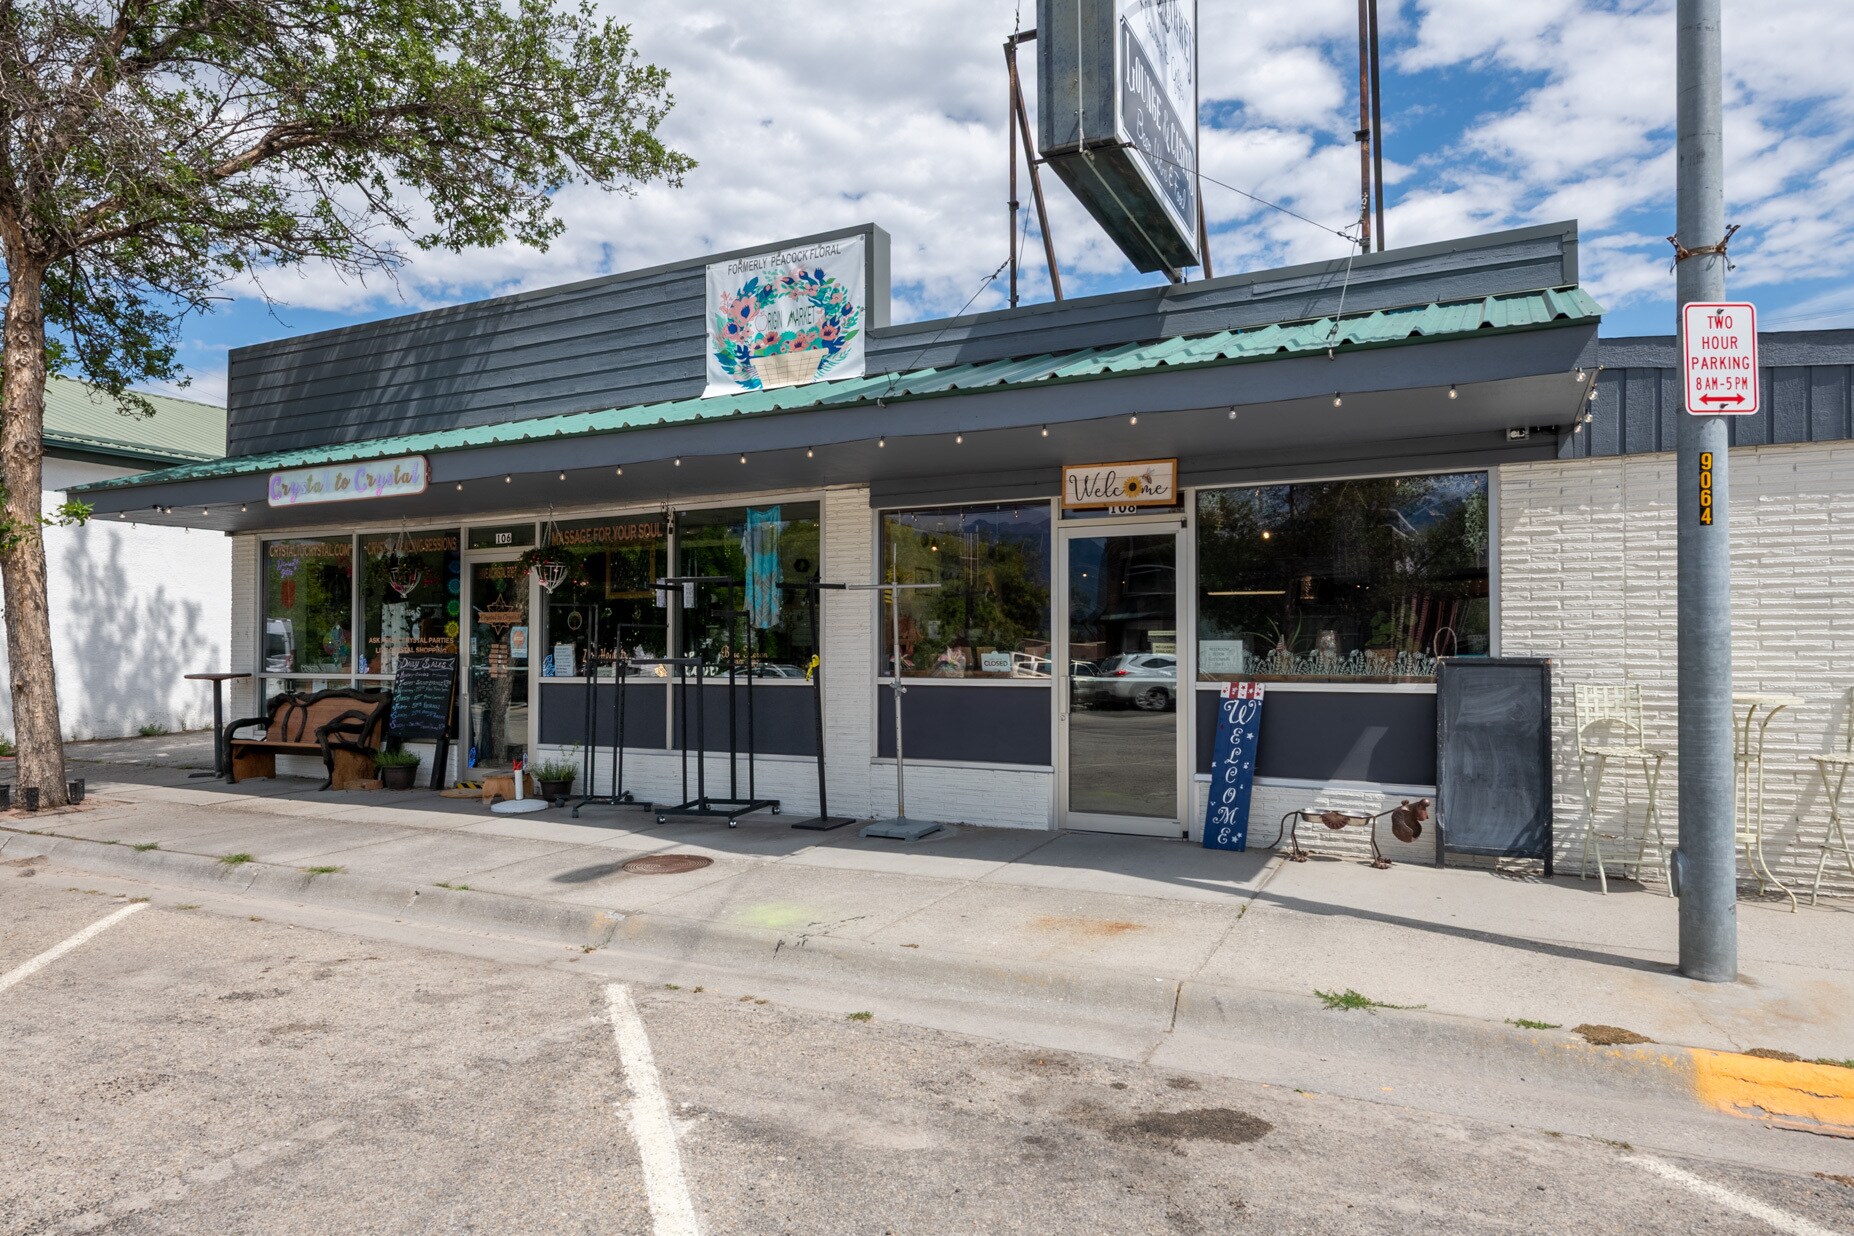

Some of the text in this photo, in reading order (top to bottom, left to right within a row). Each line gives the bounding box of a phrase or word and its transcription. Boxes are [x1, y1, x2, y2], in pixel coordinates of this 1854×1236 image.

[1125, 29, 1161, 132] LOUNGE
[728, 243, 842, 276] FORMERLY PEACOCK FLORAL
[1707, 315, 1733, 330] TWO
[1701, 336, 1738, 350] HOUR
[1691, 356, 1750, 370] PARKING
[269, 460, 420, 504] Crystal to Crystal
[1068, 470, 1169, 502] Welcome
[1700, 452, 1713, 525] 9064
[496, 533, 512, 544] 106
[551, 522, 663, 546] MASSAGE FOR YOUR SOUL
[1212, 699, 1257, 845] WELCOME
